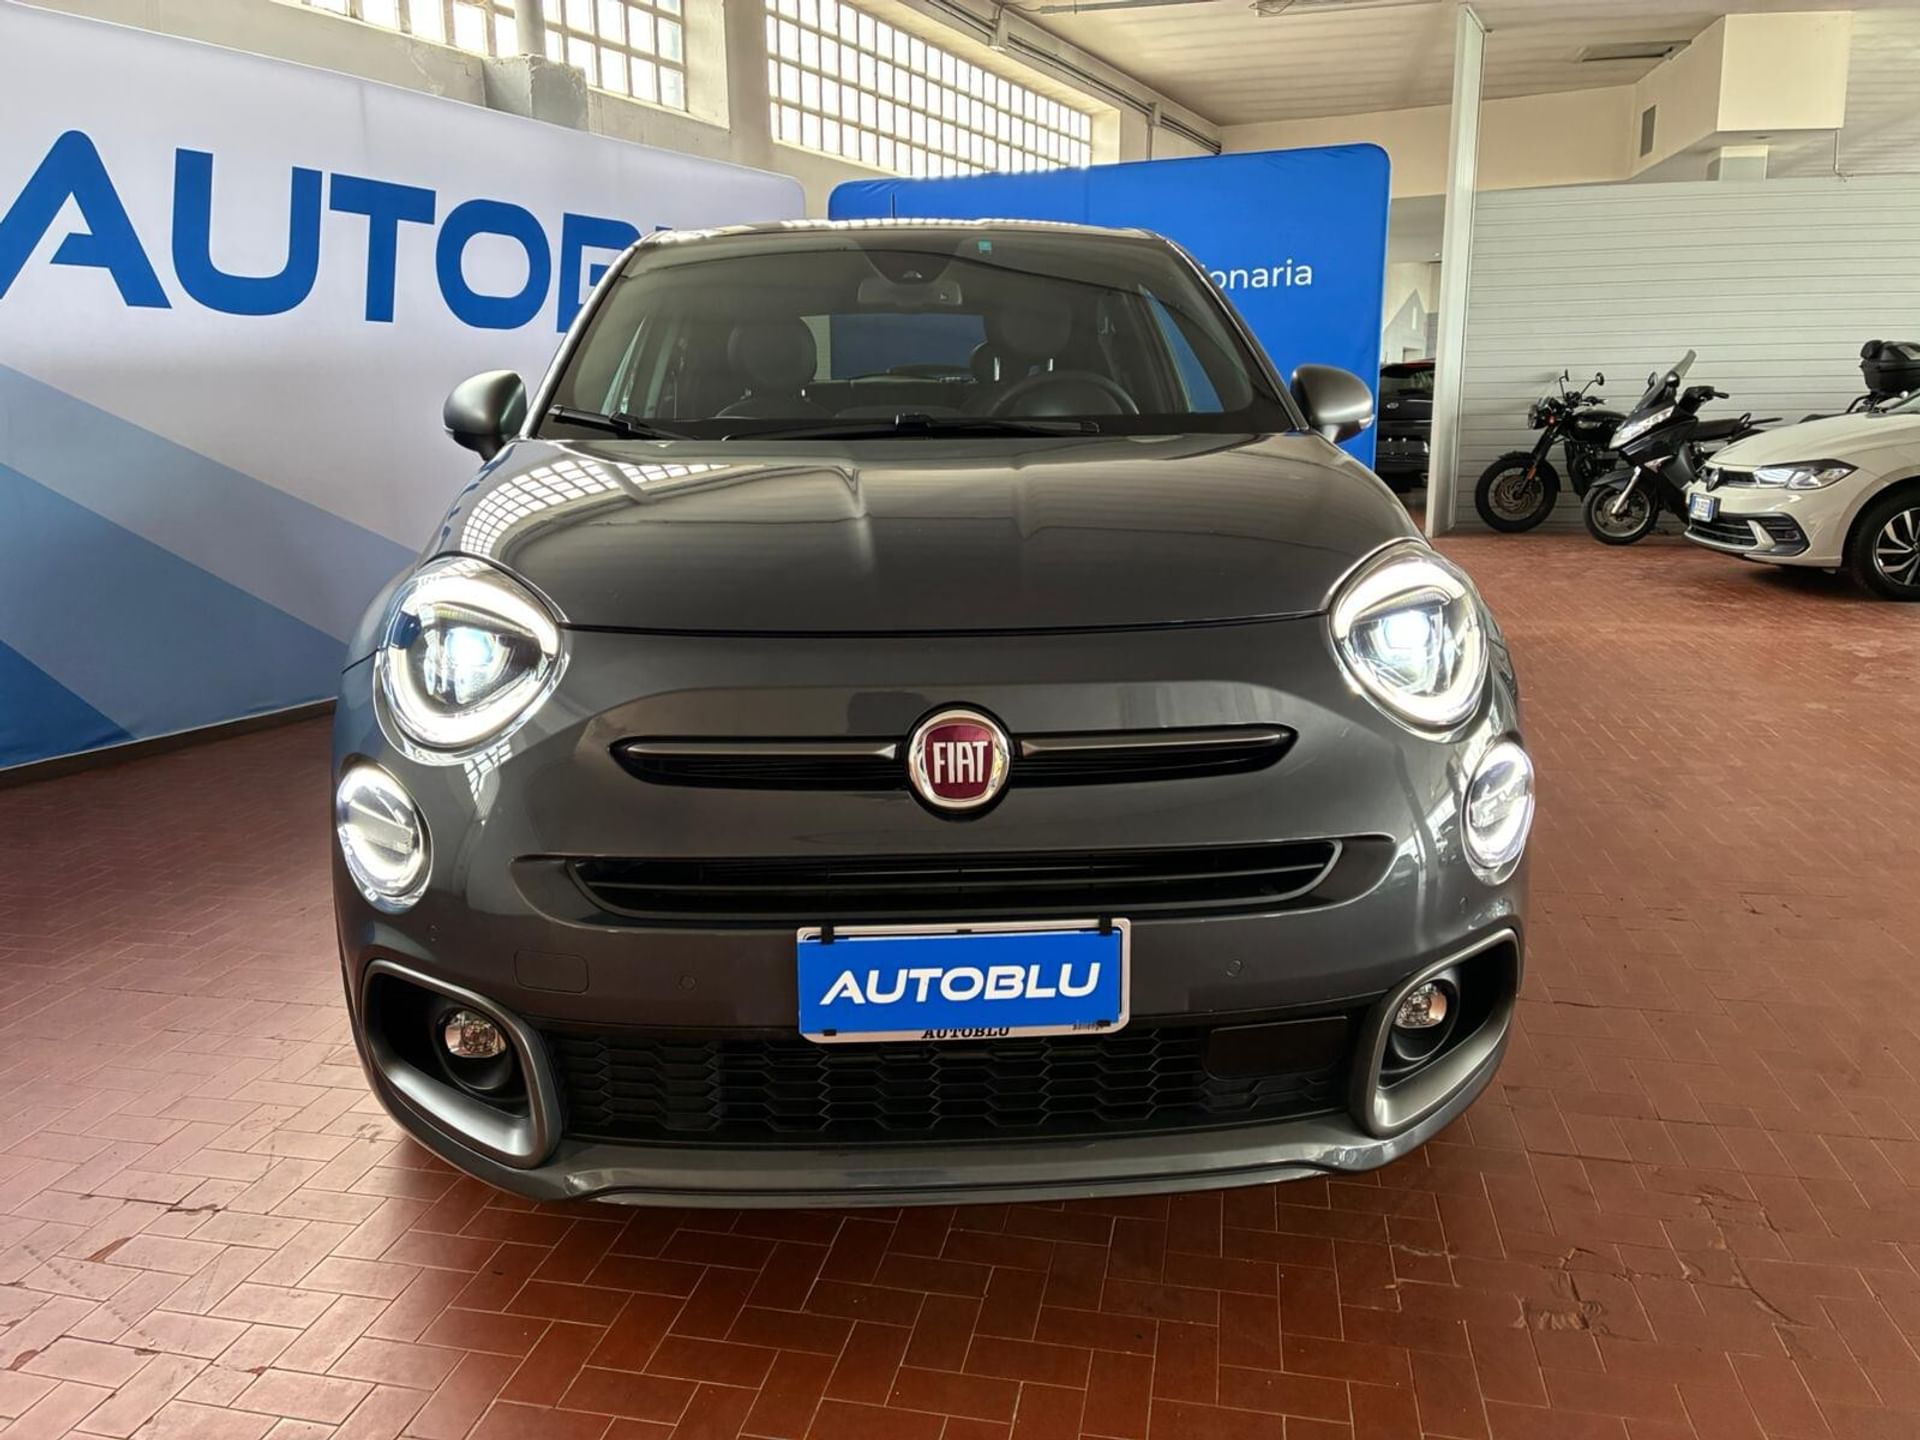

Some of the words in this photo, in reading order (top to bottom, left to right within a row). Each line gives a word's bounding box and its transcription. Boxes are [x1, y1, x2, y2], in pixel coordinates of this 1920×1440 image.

[0, 130, 672, 333] AUTOB
[1202, 258, 1313, 289] onaria
[932, 741, 988, 784] FIAT
[820, 962, 1101, 1006] AUTOBLU
[921, 1027, 1010, 1040] AUTOBLU
